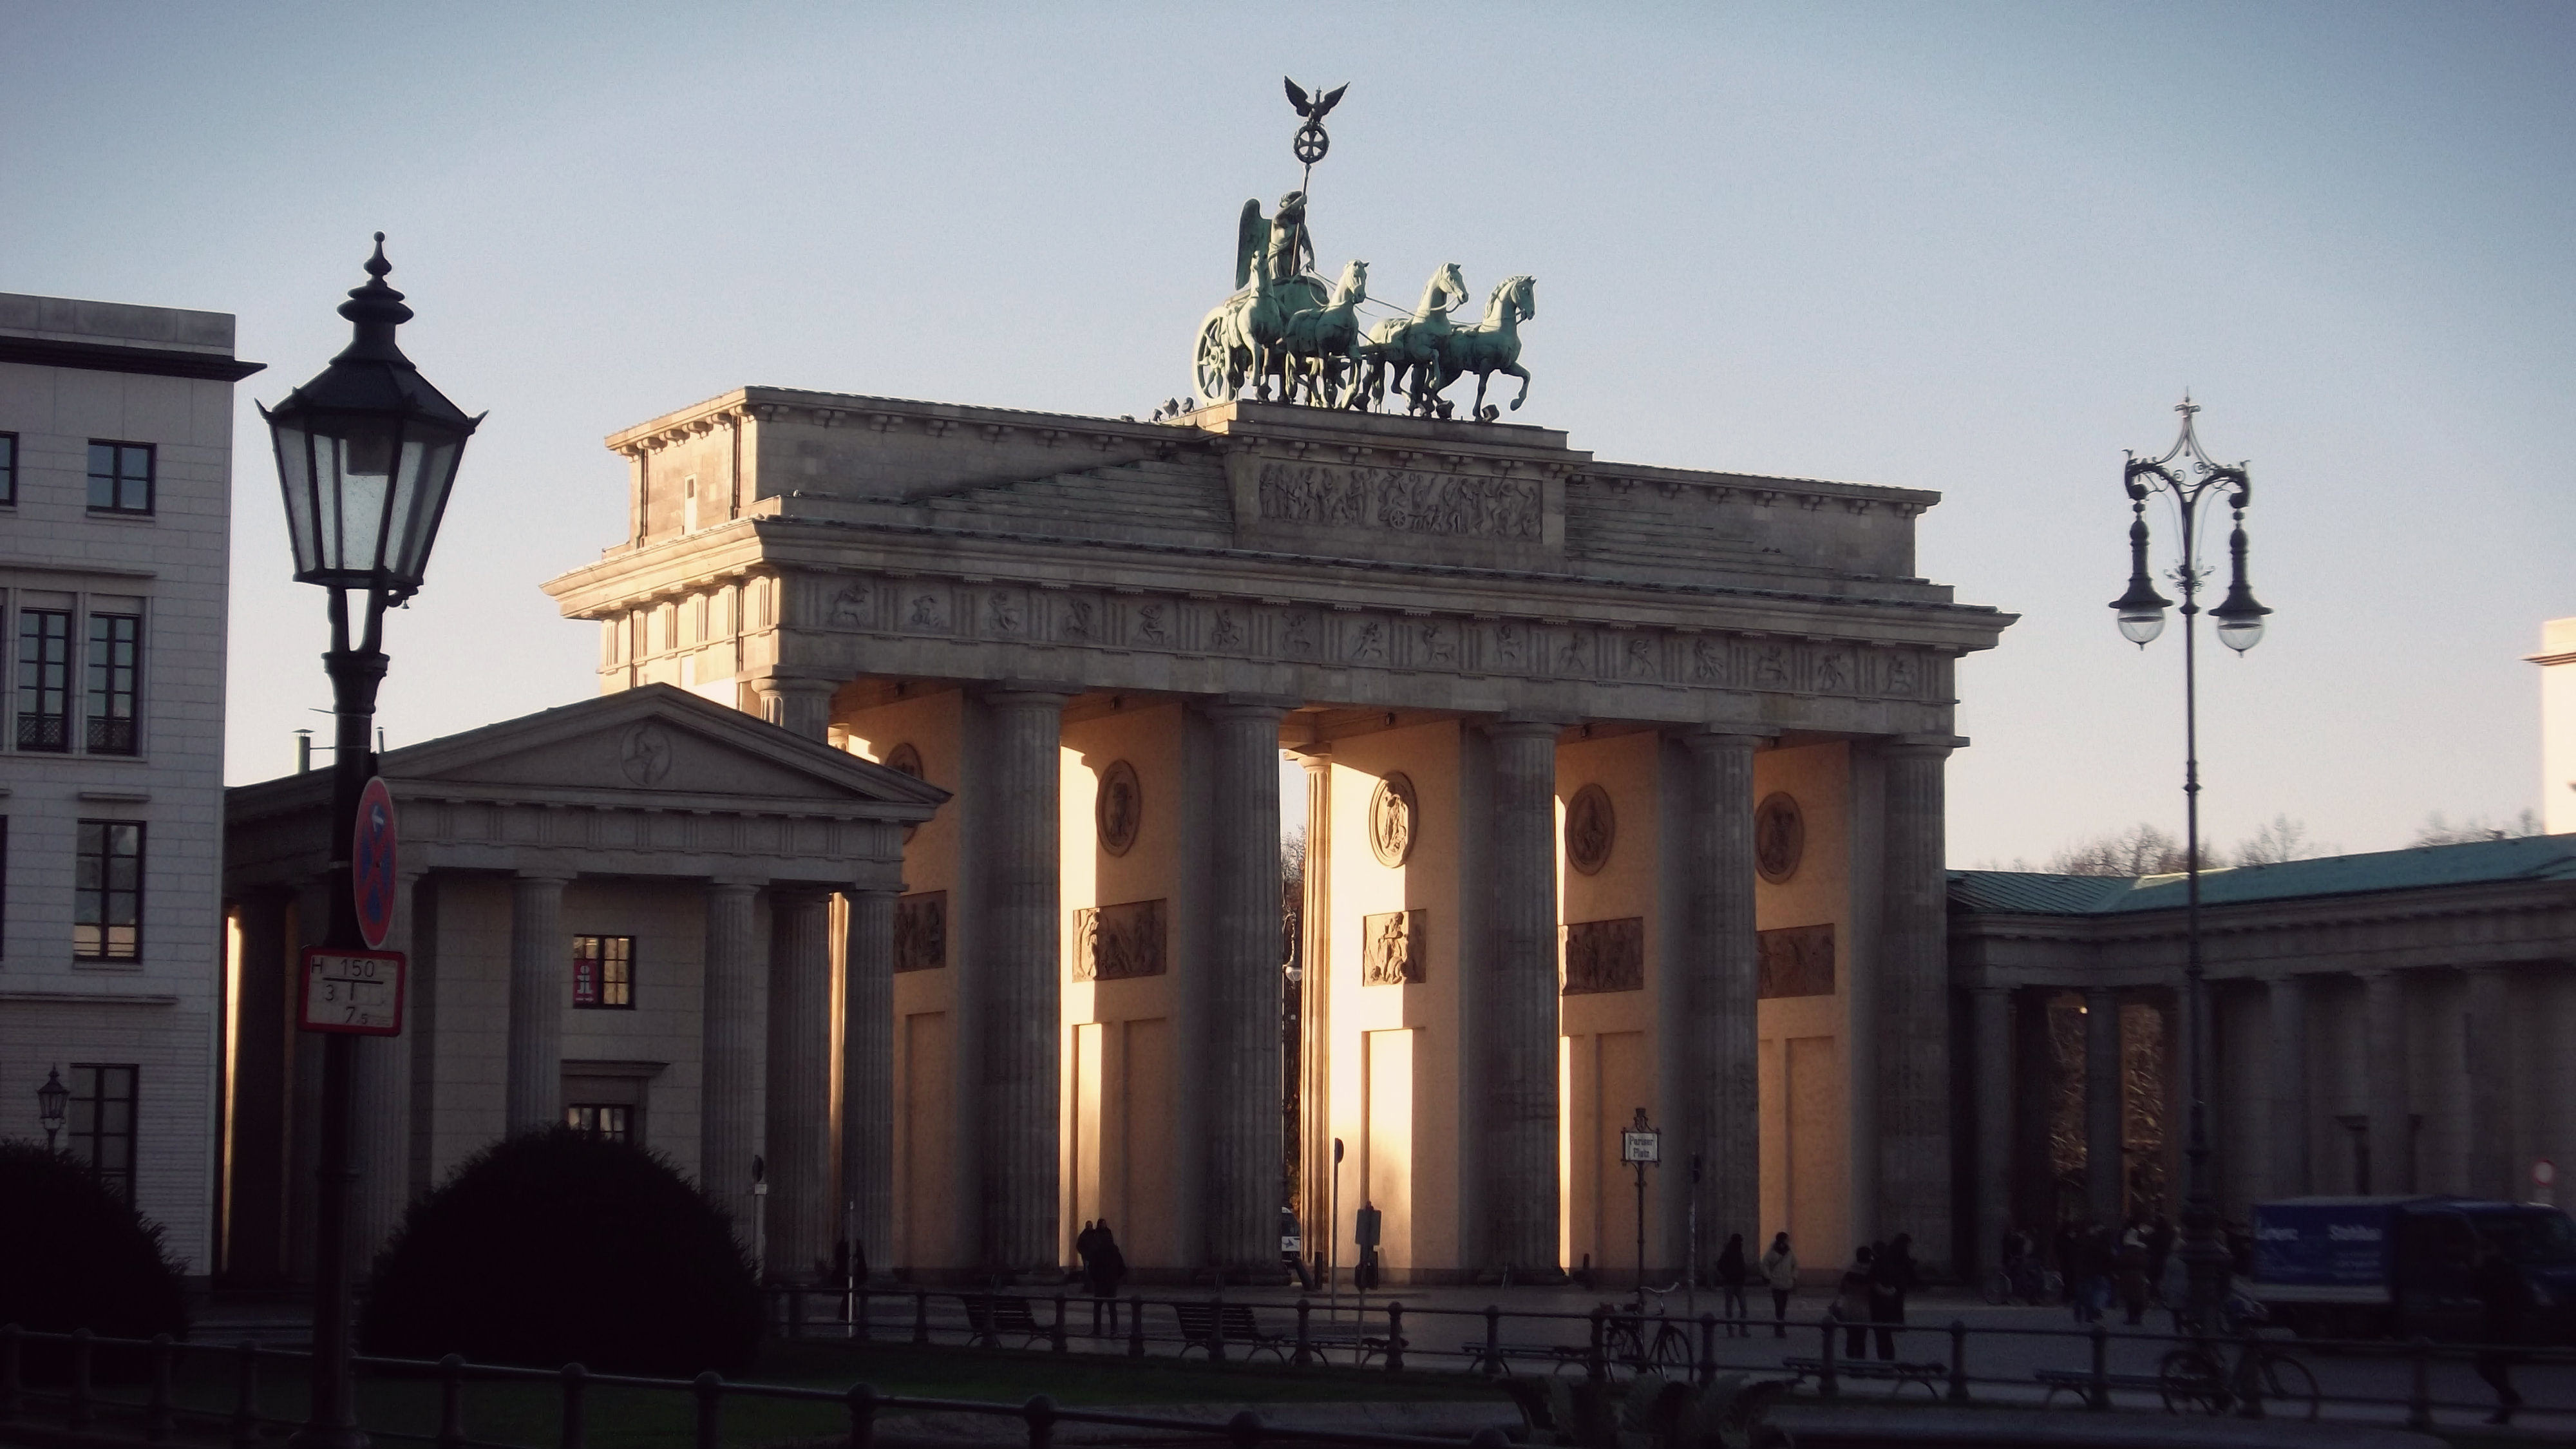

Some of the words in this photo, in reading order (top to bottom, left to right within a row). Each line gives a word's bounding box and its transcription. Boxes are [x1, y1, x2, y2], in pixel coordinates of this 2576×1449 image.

[312, 957, 323, 974] H
[341, 959, 374, 977] 150
[325, 984, 334, 1001] 3
